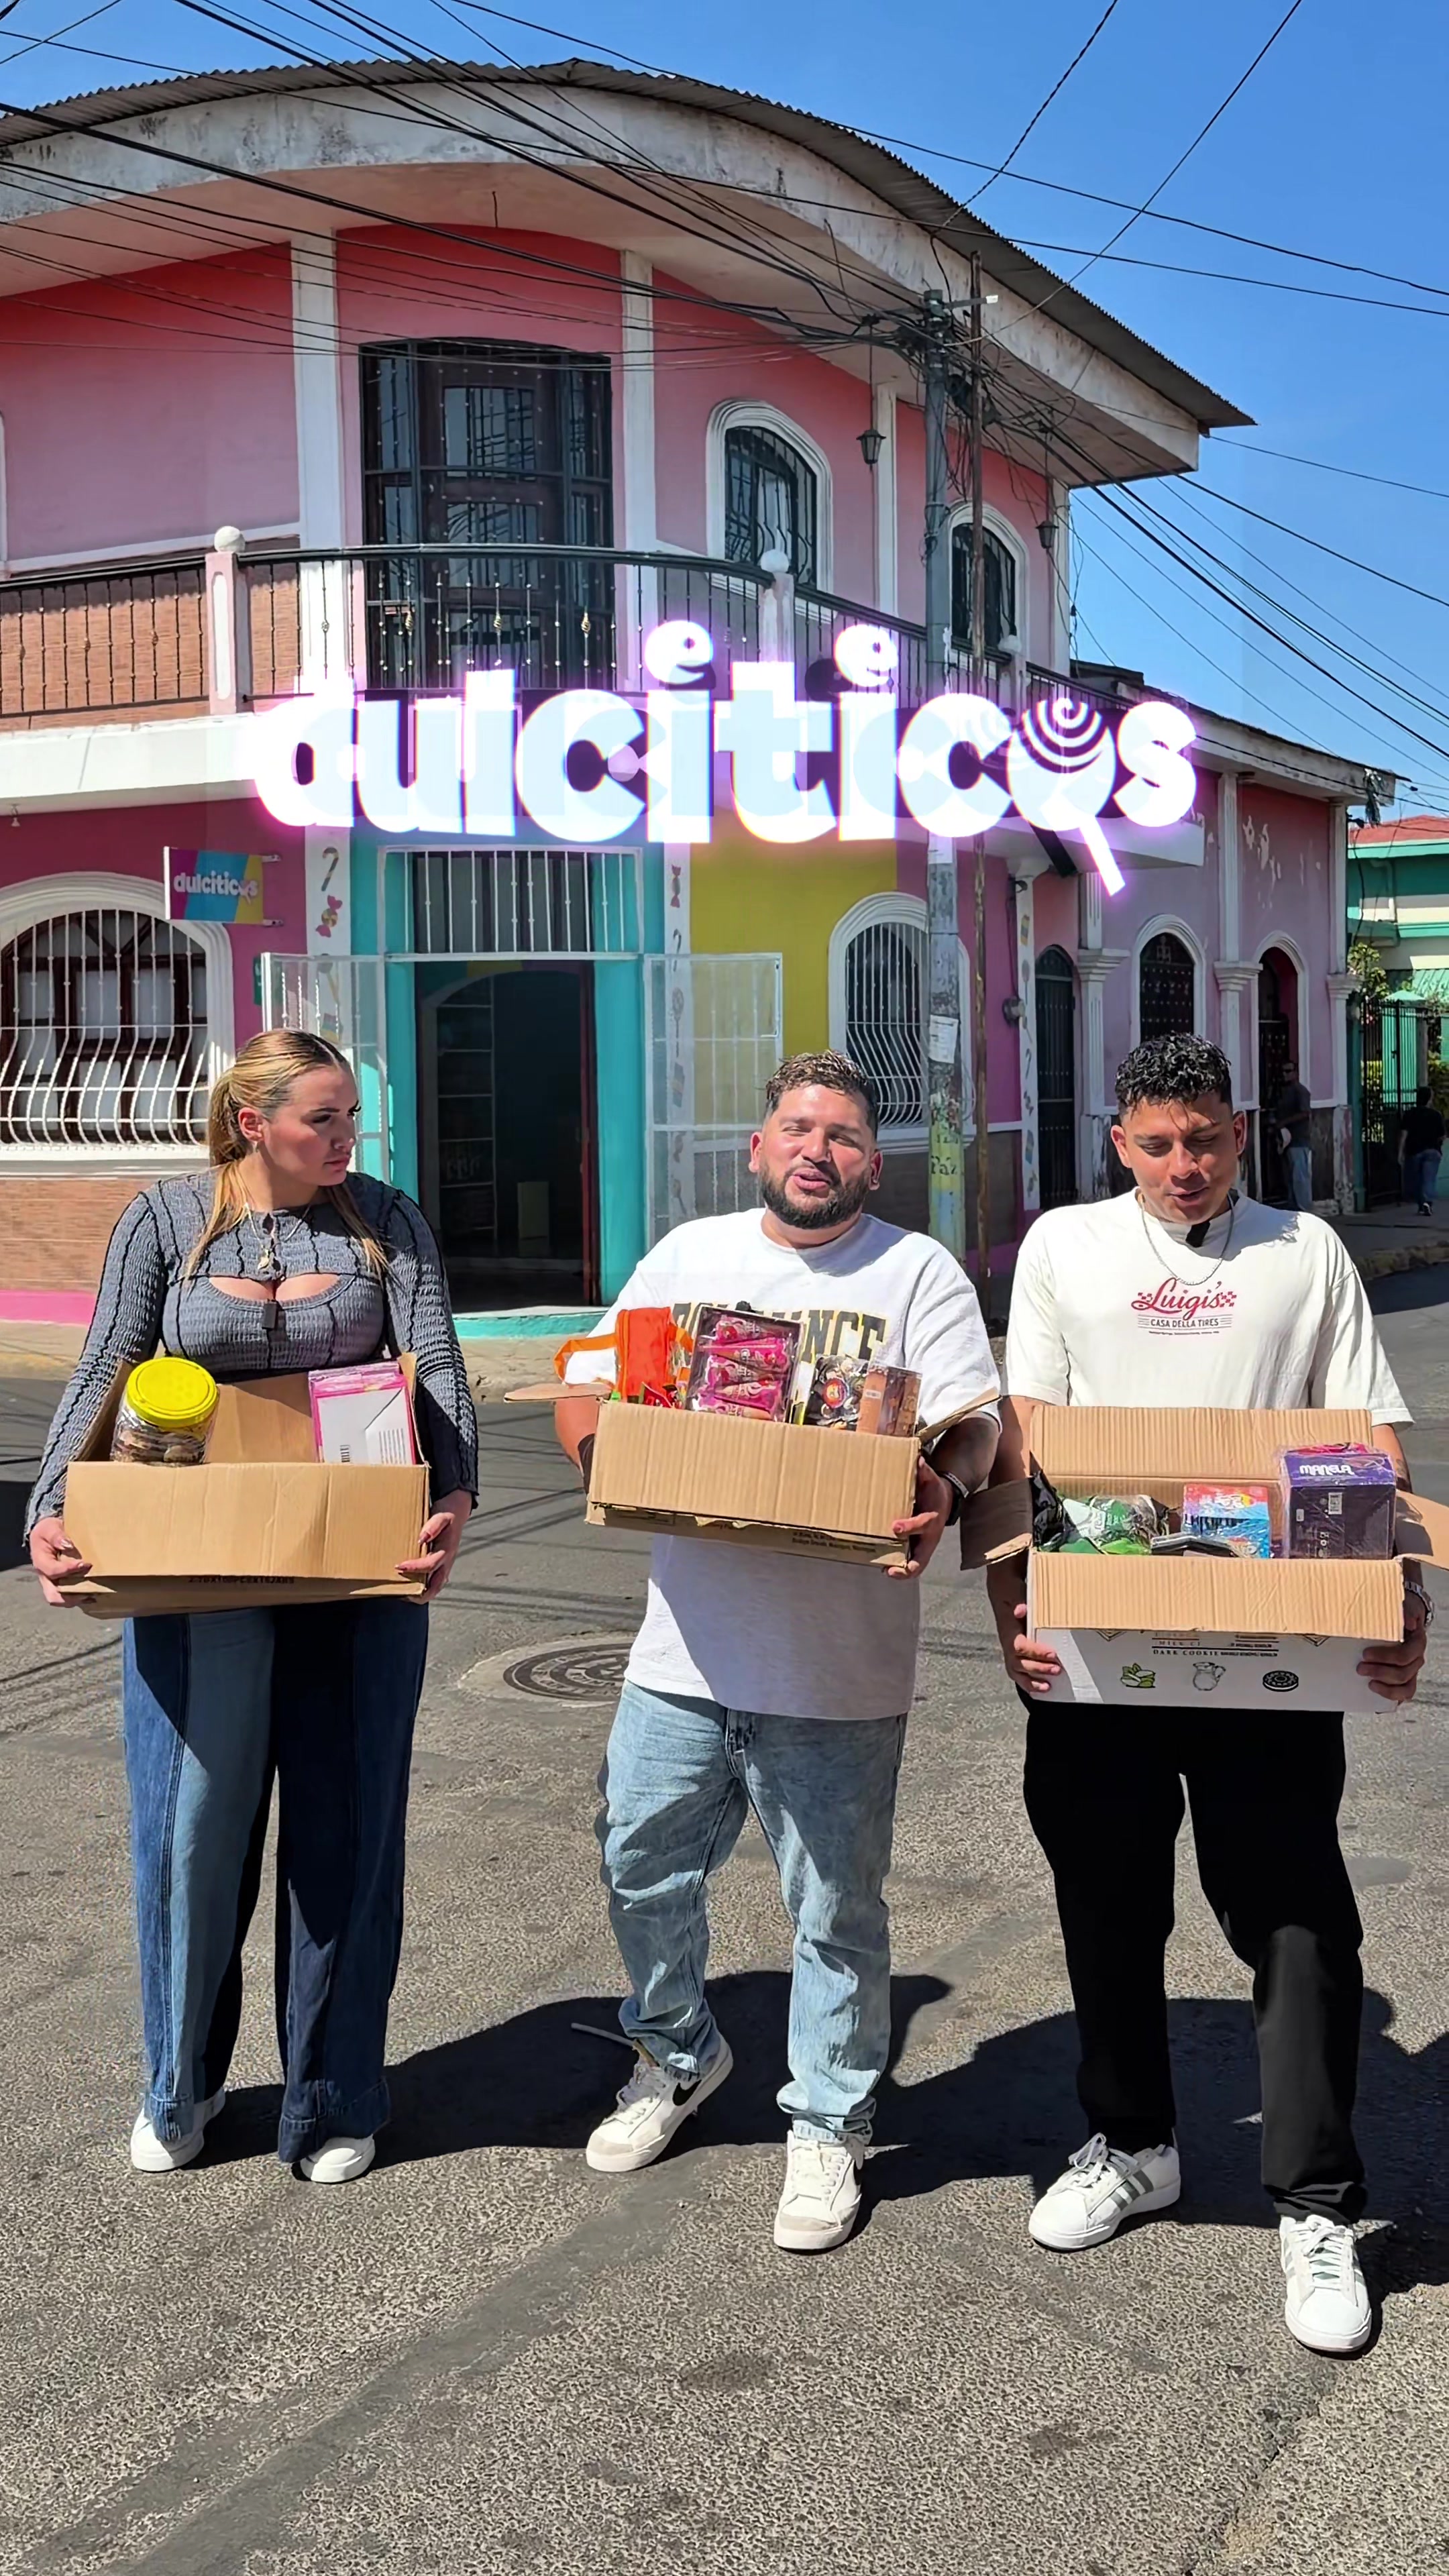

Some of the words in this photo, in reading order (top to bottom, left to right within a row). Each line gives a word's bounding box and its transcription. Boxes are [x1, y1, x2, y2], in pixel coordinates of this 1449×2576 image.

[173, 870, 258, 904] dulciticos
[1131, 1277, 1222, 1321] Luigi's
[1150, 1318, 1171, 1328] CASA
[1171, 1320, 1196, 1328] DELLA
[1197, 1318, 1220, 1327] TIRES
[1182, 1650, 1218, 1658] COOKIE
